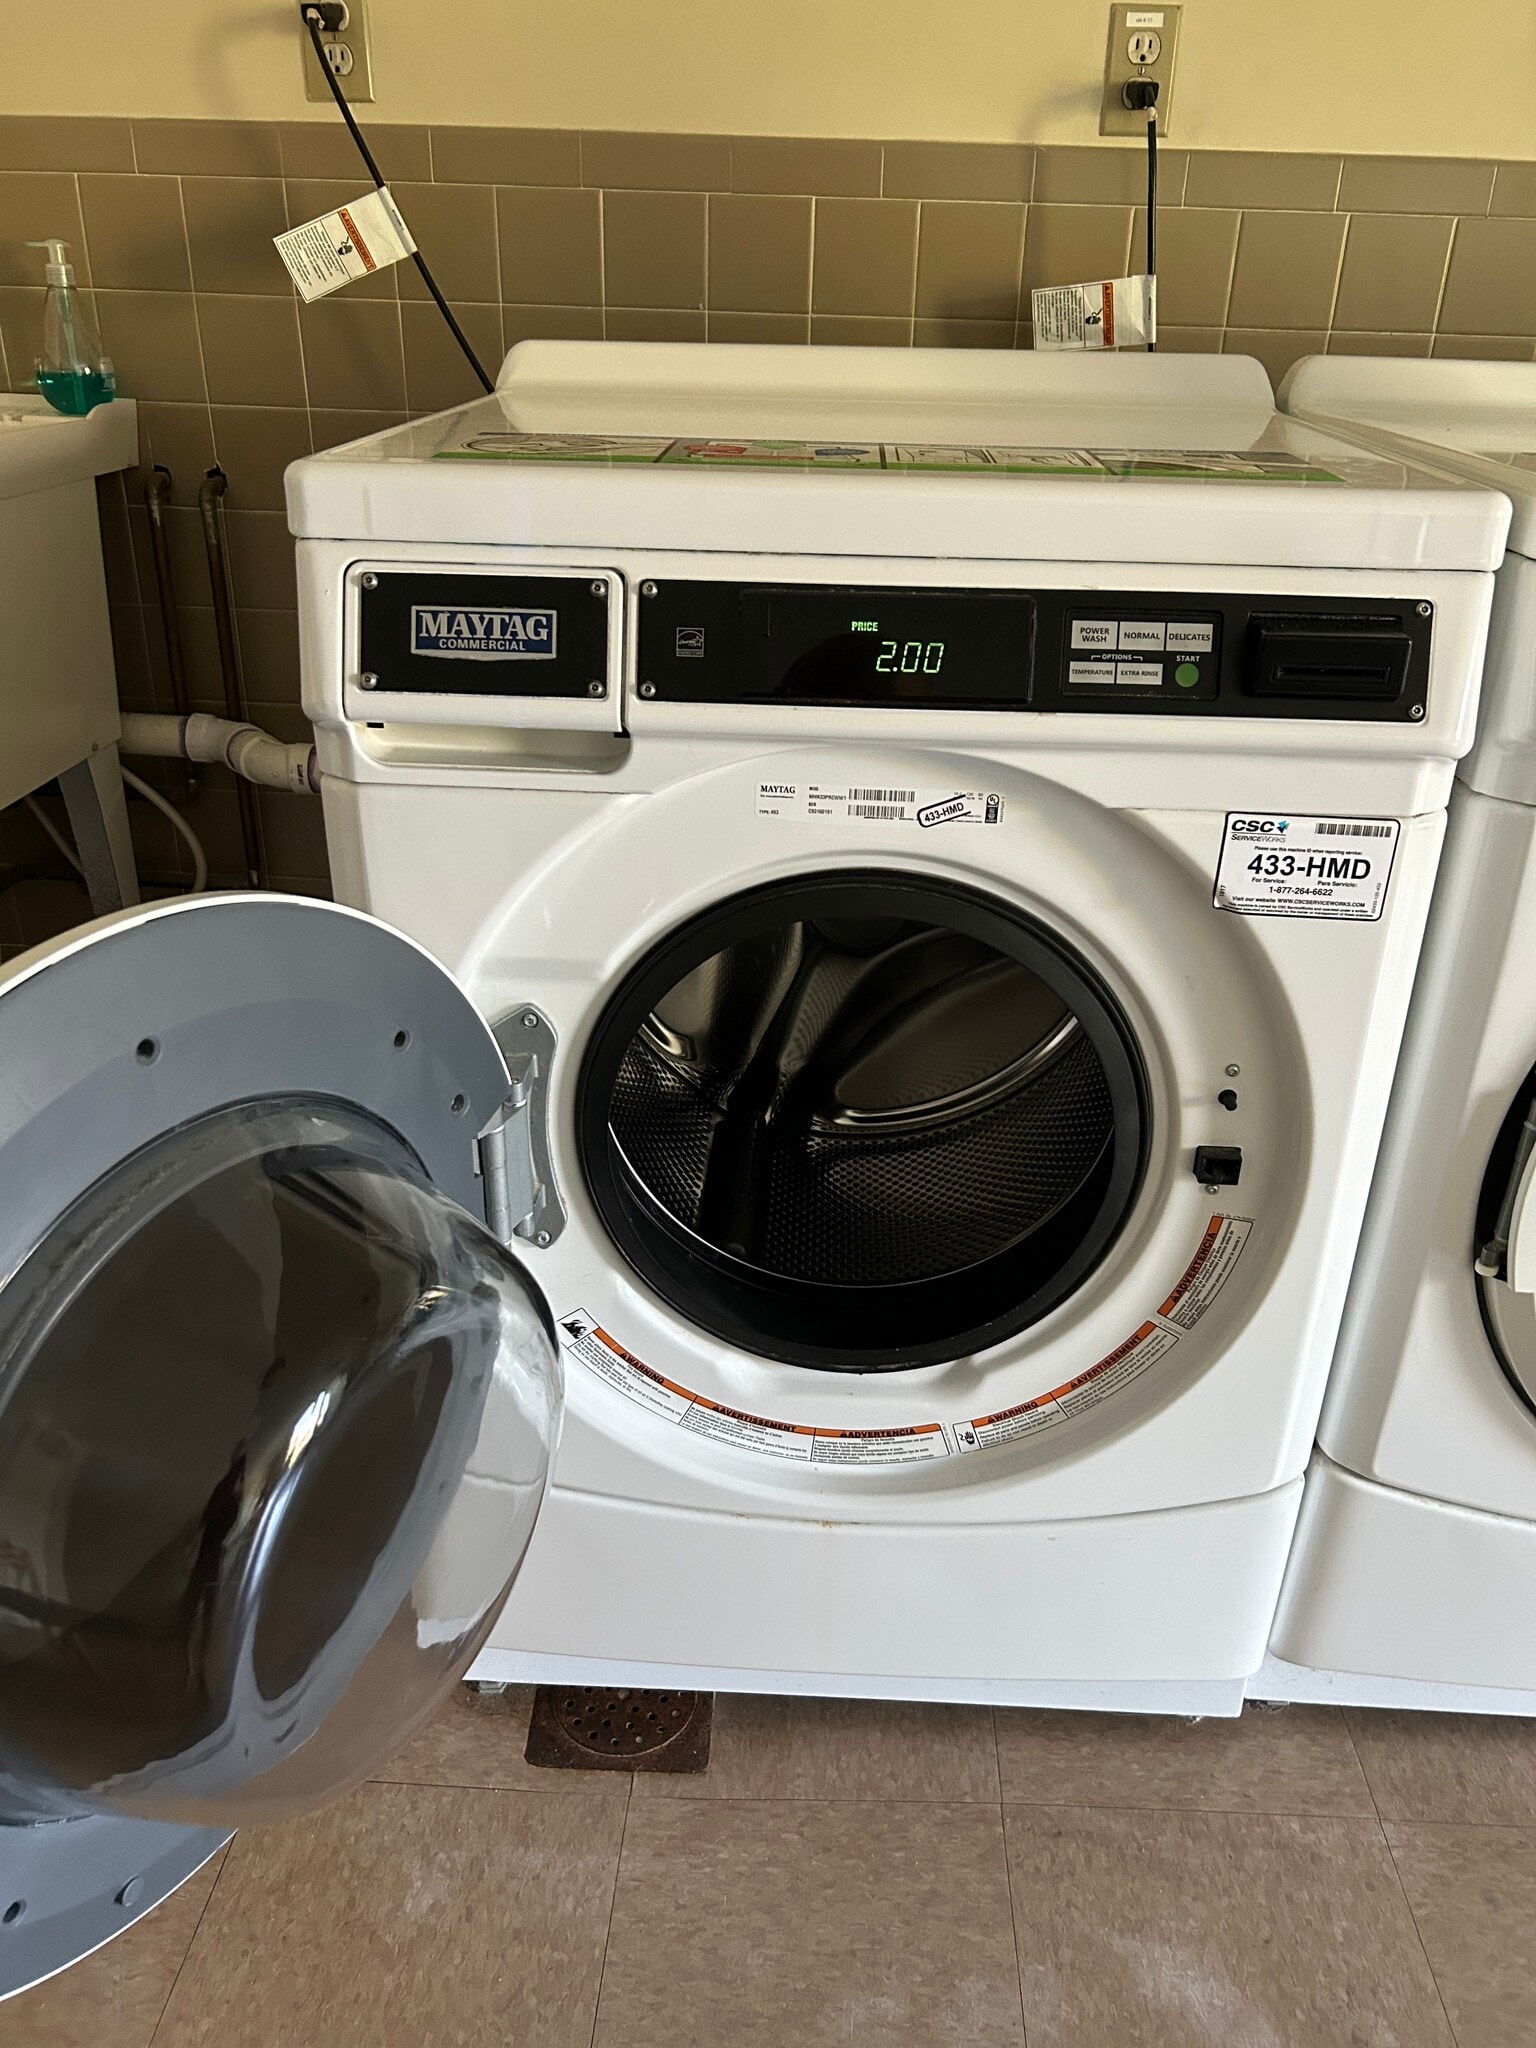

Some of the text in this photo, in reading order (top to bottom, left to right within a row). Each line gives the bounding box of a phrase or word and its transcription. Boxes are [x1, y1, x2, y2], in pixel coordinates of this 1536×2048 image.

[419, 611, 549, 640] MAYTAG
[851, 621, 878, 632] PRICE
[1080, 627, 1110, 635] POWER
[1082, 635, 1107, 643] WASH
[1124, 632, 1160, 640] NORMAL
[1168, 633, 1210, 641] DELICATES
[439, 639, 526, 651] COMMERCIAL
[875, 641, 945, 673] 2.00
[760, 785, 796, 794] MAYTAG
[924, 802, 964, 822] 433-HMD
[1231, 819, 1275, 833] CSC
[1247, 854, 1371, 880] 433-HMD
[1269, 886, 1333, 897] 1-877-264-6622
[1277, 898, 1366, 907] WWW.CSCSERVICEWORKS.COM
[1176, 1232, 1217, 1298] ADVERTENCIA
[1076, 1335, 1142, 1384] AVERTISSEMENT
[625, 1353, 665, 1385] WARNING
[994, 1401, 1038, 1421] WARNING
[719, 1408, 797, 1433] AVERTISSEMENT
[848, 1428, 917, 1438] ADVERTENCIA
